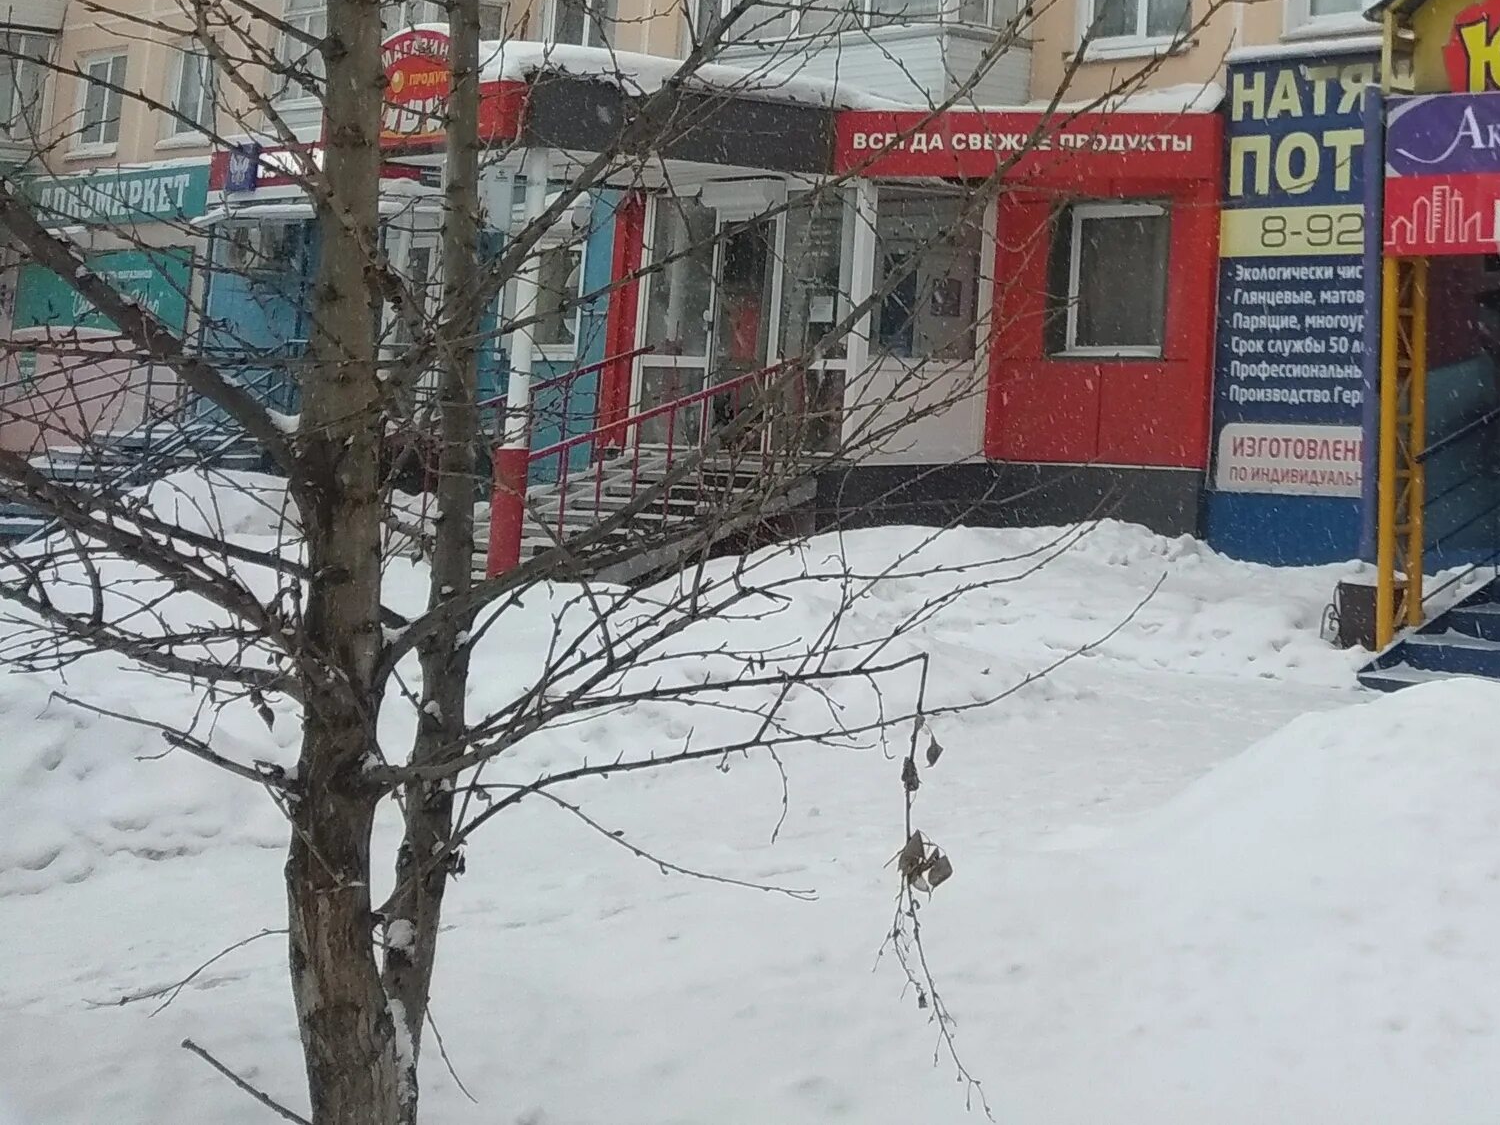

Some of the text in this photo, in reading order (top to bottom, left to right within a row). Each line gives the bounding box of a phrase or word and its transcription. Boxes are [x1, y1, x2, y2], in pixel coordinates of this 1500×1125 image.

[1059, 133, 1192, 152] ПРОДУКТЫ
[1229, 129, 1365, 197] ПОТ
[1261, 213, 1364, 248] 8-92
[1235, 264, 1363, 281] Экологически чис
[1233, 288, 1365, 306] Глянцевые, матов
[1233, 312, 1300, 332] Парящие,
[1231, 336, 1264, 356] Срок
[1267, 336, 1325, 357] службы
[1329, 336, 1349, 354] 50
[1229, 385, 1330, 404] Производство
[1229, 466, 1248, 482] ПО
